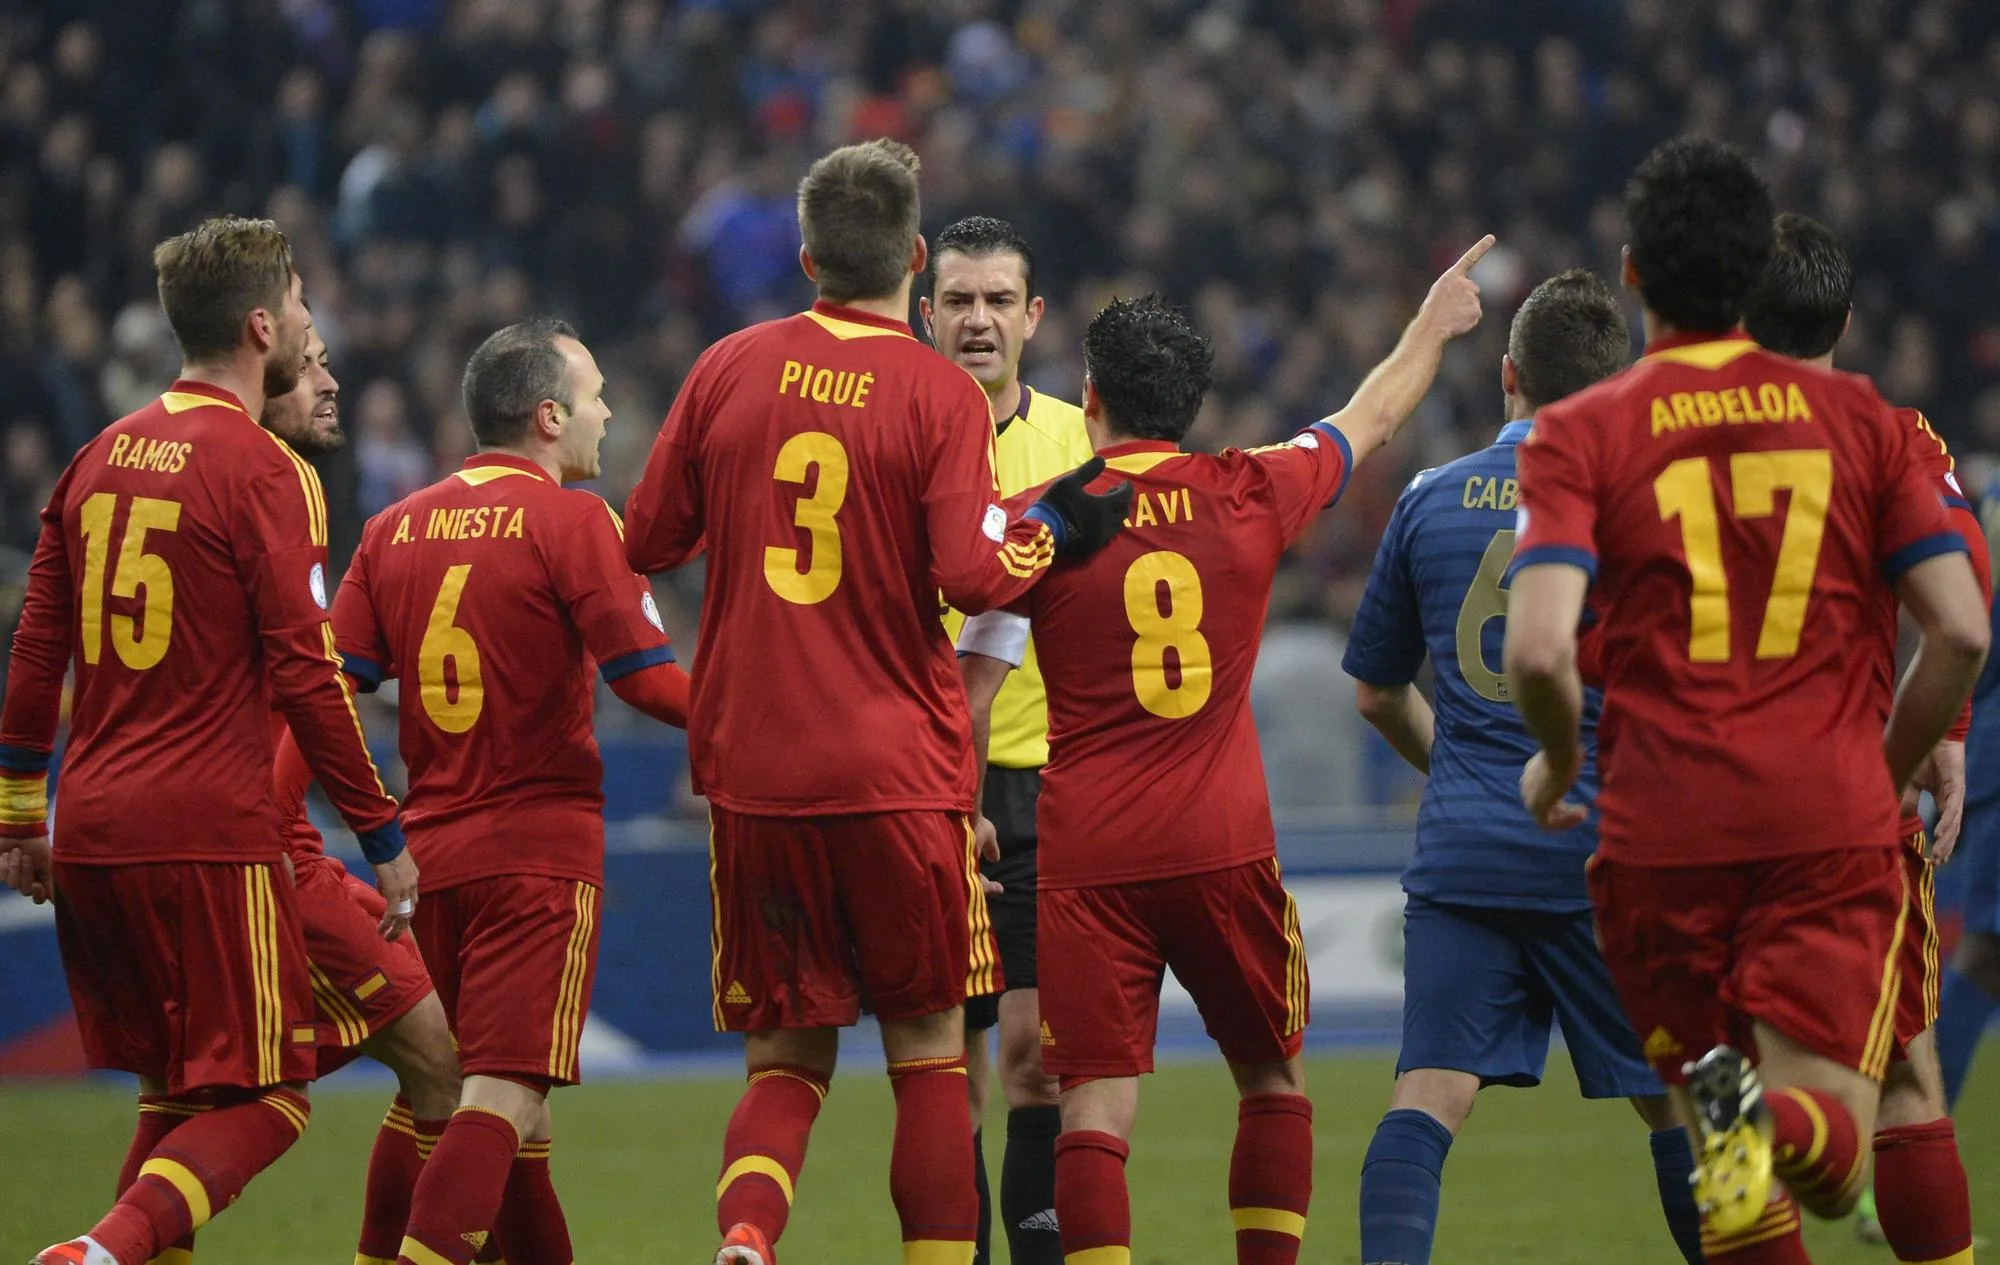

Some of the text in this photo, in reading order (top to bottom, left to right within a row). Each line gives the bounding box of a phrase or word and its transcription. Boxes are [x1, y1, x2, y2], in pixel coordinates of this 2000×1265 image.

[779, 360, 875, 408] PIQUÉ
[1651, 382, 1812, 439] ARBELOA
[108, 433, 193, 474] RAMOS
[764, 432, 849, 604] 3
[1123, 487, 1193, 528] AVI
[1463, 476, 1520, 511] CAB
[391, 506, 525, 545] A. INIESTA
[80, 492, 182, 671] 15
[1654, 449, 1833, 662] 17
[418, 564, 484, 734] 6
[1123, 550, 1213, 718] 8
